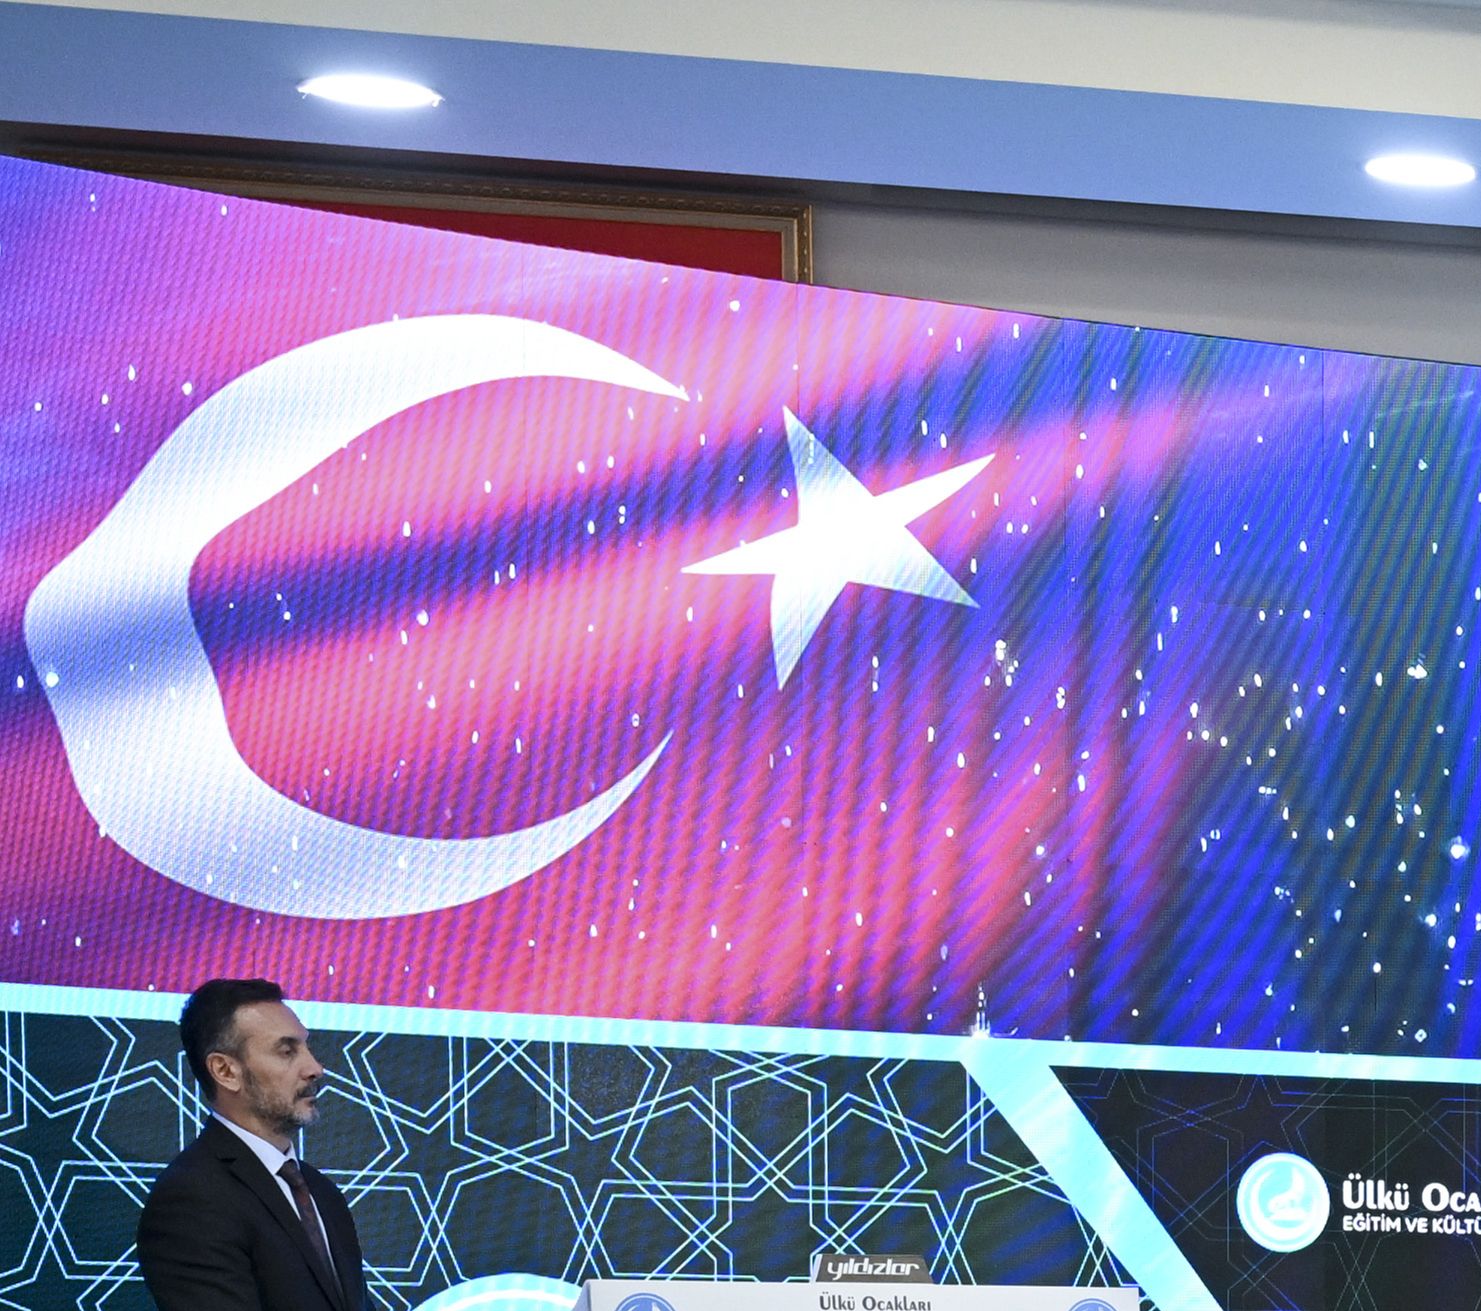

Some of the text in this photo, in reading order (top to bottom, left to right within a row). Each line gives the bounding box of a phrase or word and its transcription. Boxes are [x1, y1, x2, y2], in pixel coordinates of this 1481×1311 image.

[1342, 1173, 1410, 1211] Ülkü
[1342, 1212, 1401, 1233] EĞİTİM
[1405, 1217, 1428, 1233] VE
[818, 1291, 856, 1311] Ülkü
